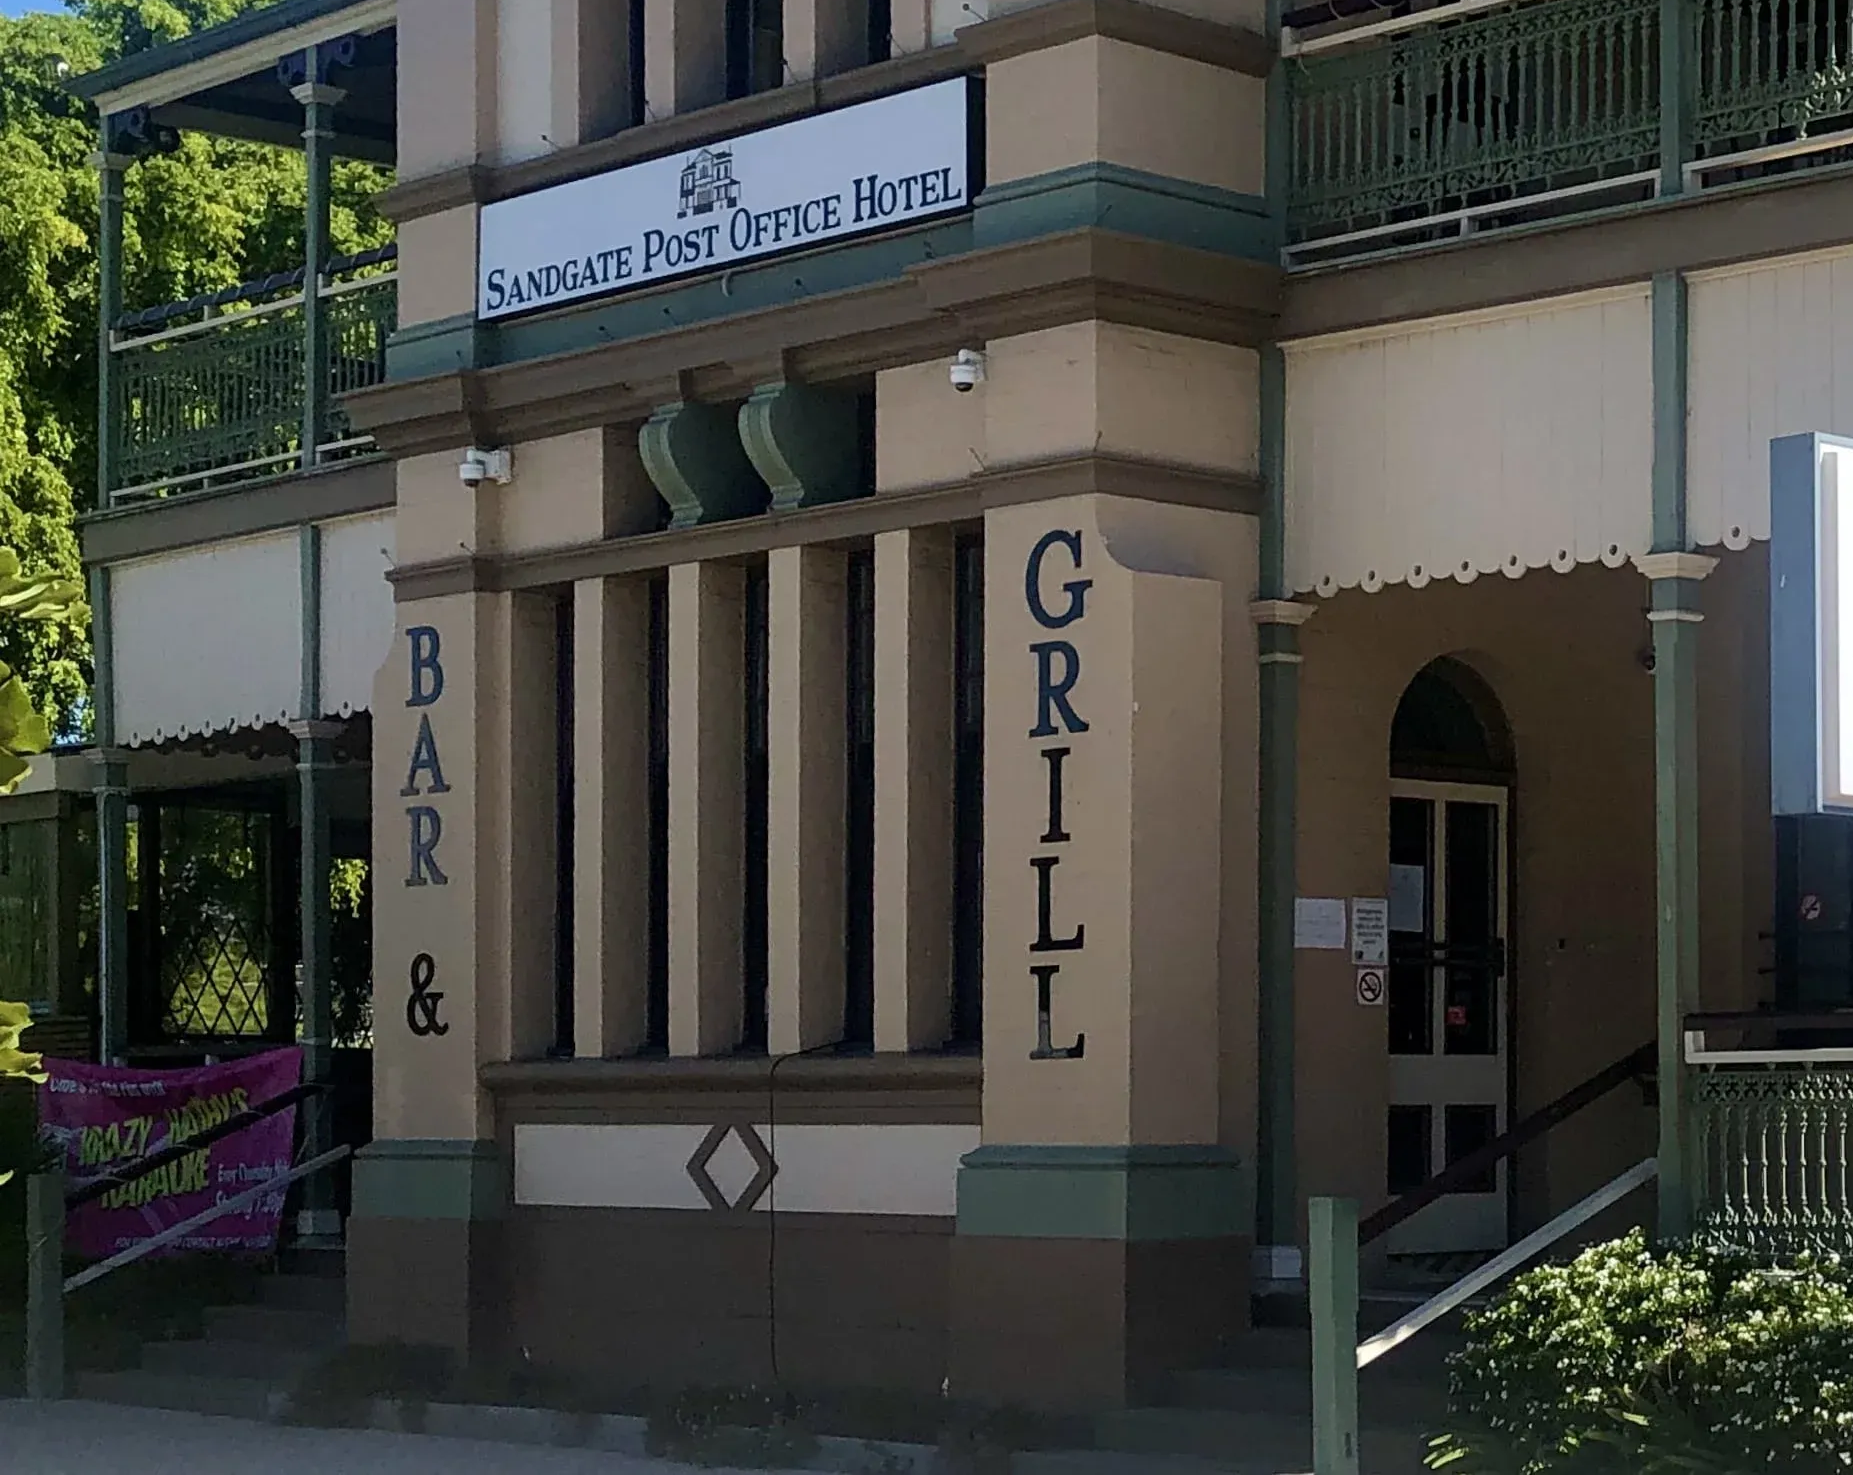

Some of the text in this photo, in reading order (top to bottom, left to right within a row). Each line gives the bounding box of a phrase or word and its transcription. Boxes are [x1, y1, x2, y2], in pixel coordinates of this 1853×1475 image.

[487, 167, 961, 311] SANDGATE POST OFFICE HOTEL
[401, 625, 450, 1036] BAR &
[1025, 529, 1093, 1061] GRILL
